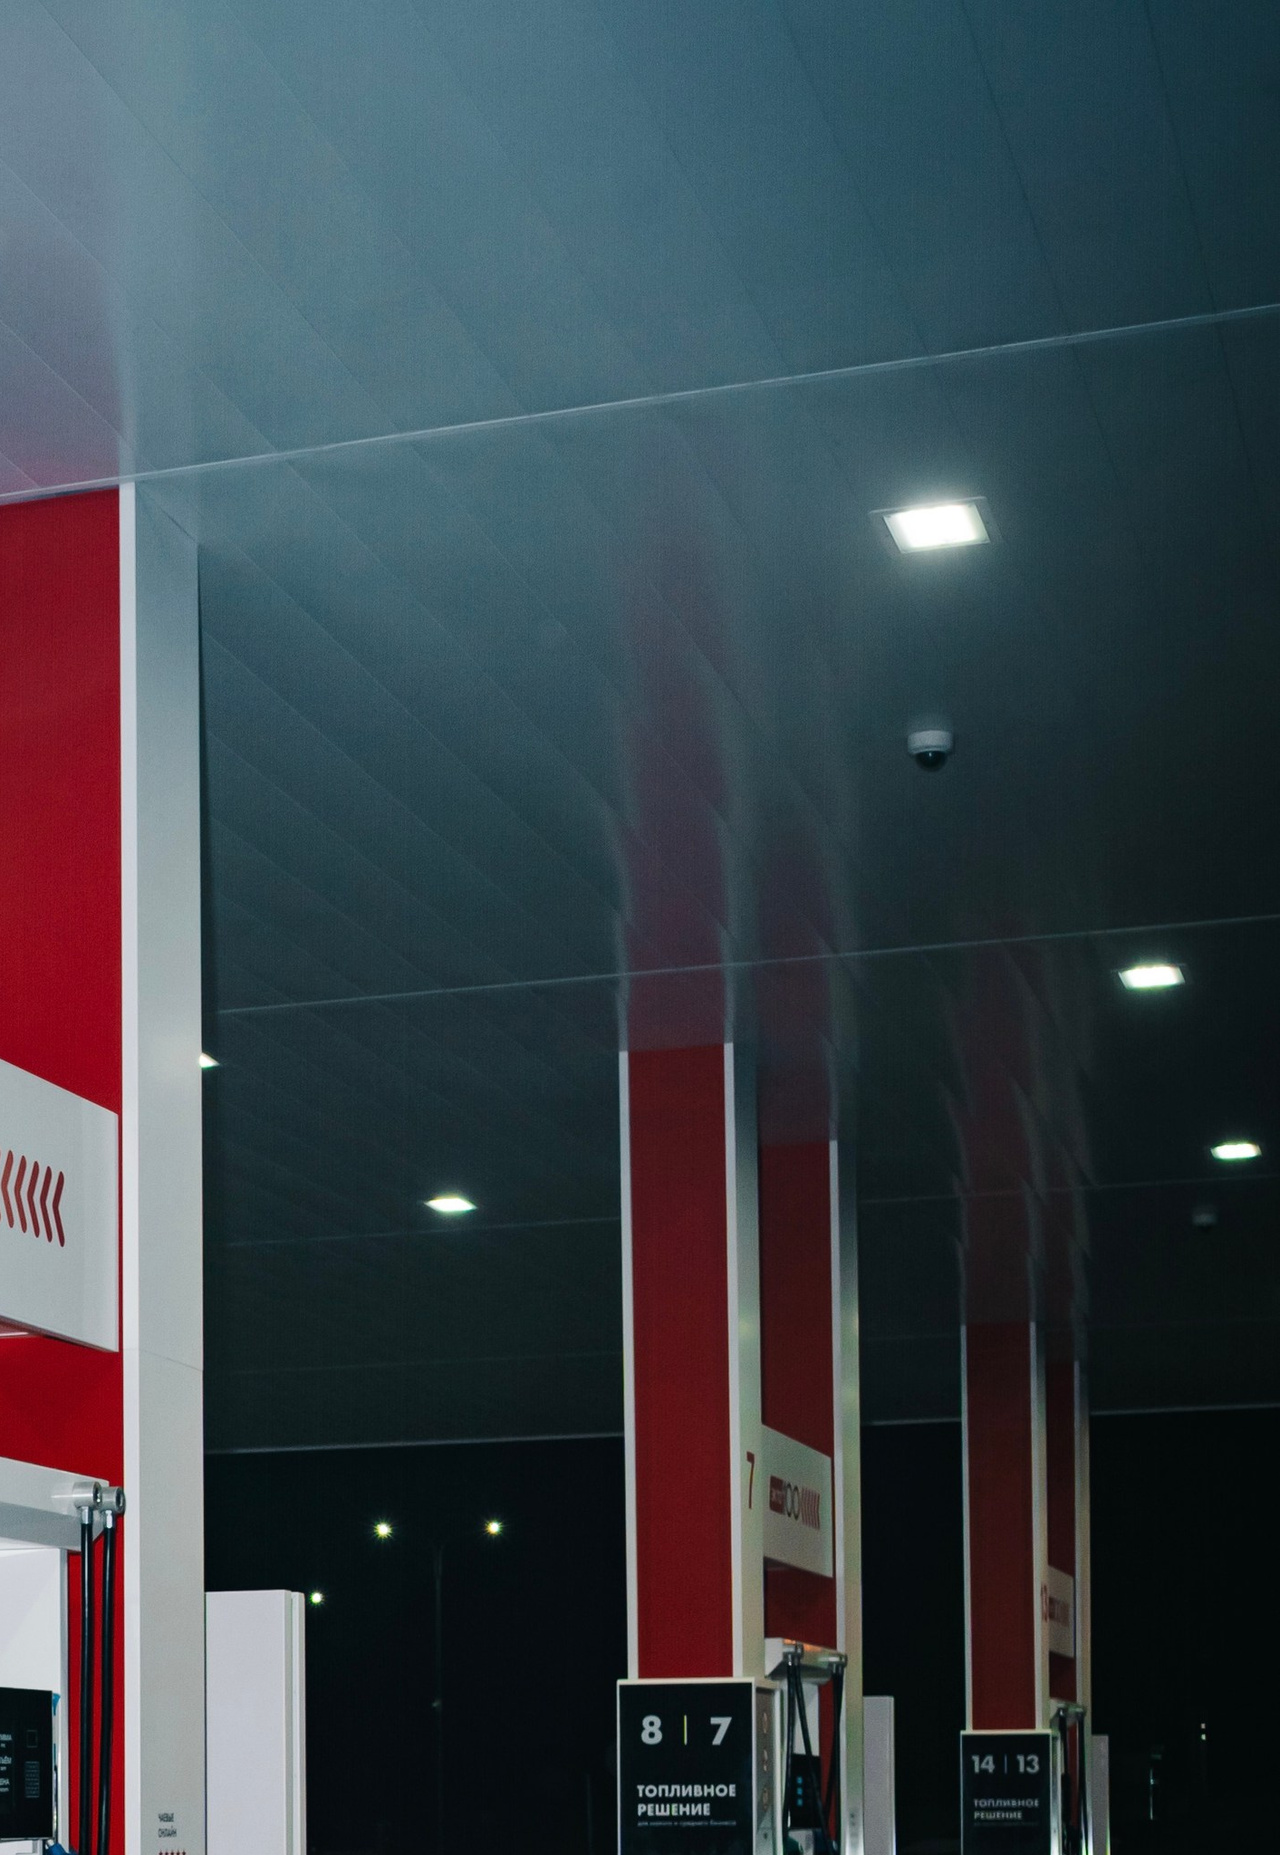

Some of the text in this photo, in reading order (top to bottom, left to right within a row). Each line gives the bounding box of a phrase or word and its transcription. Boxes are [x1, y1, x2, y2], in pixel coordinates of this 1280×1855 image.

[640, 1715, 733, 1746] 8 7
[971, 1754, 1040, 1774] 14 13
[636, 1783, 737, 1798] ТОПЛИВНОЕ
[637, 1802, 711, 1817] РЕШЕНИЕ
